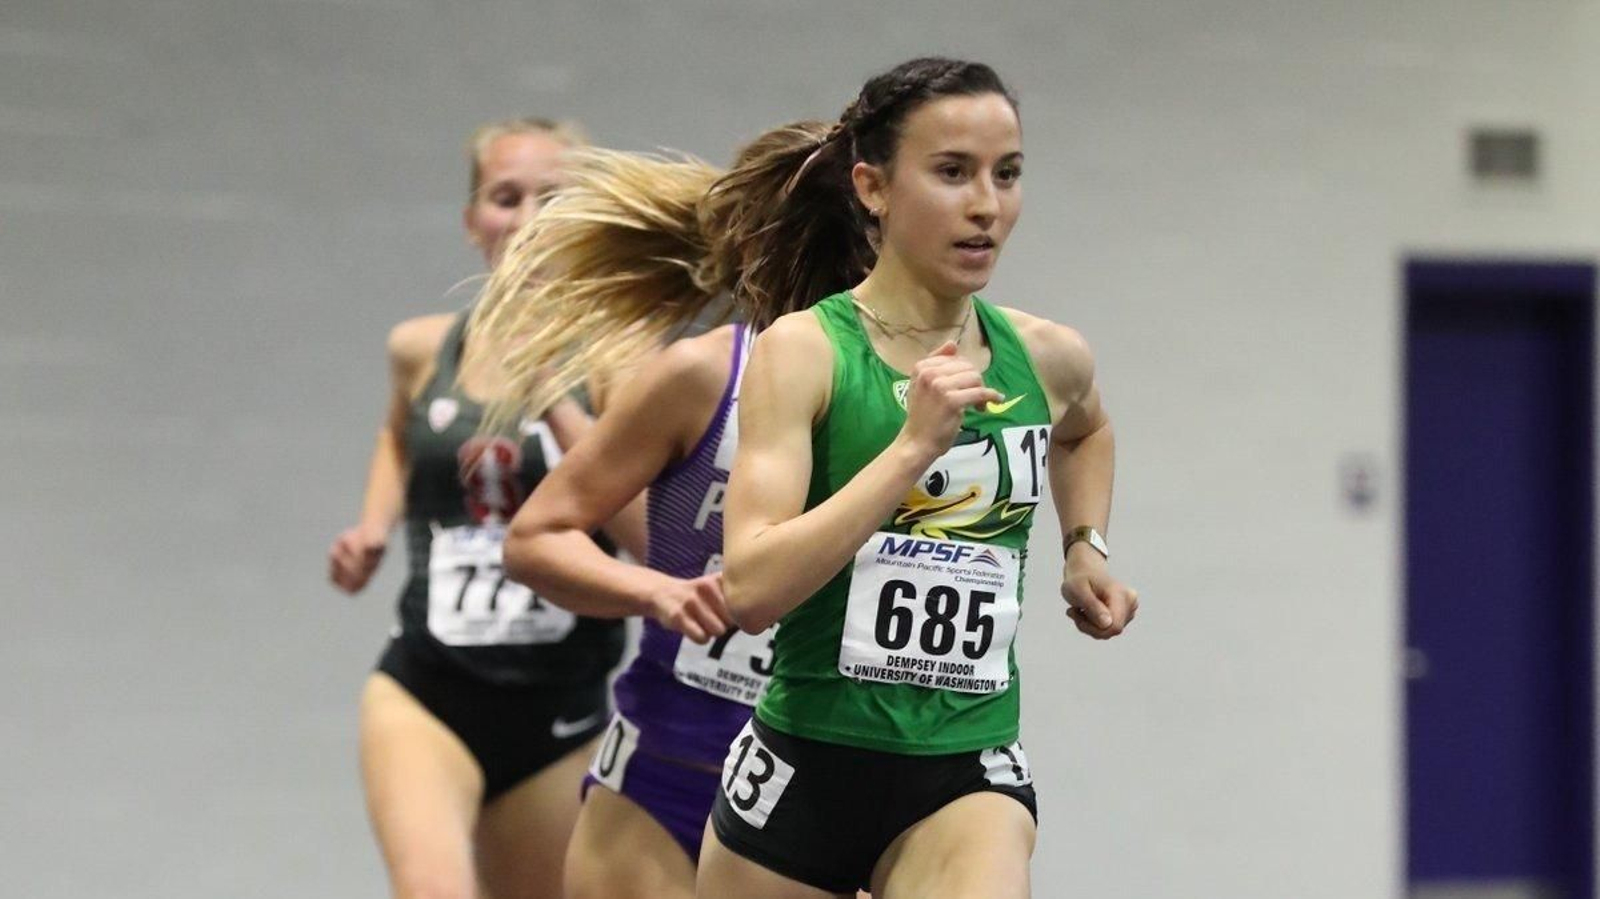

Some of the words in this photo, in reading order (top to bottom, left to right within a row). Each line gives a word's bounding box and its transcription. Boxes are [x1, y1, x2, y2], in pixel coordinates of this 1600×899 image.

[878, 536, 974, 563] MPSF
[875, 557, 916, 569] Mountain
[916, 562, 944, 573] Pacific
[946, 566, 972, 577] Sports
[972, 568, 1005, 580] Federation
[954, 575, 1005, 587] Championship
[455, 565, 546, 611] 77
[874, 579, 996, 660] 685
[717, 668, 762, 689] DEMPSEY
[853, 664, 917, 682] UNIVERSITY
[919, 673, 934, 685] OF
[934, 675, 997, 692] WASHINGTON
[886, 654, 937, 672] DEMPSEY
[937, 661, 975, 676] INDOOR
[726, 734, 775, 812] 13
